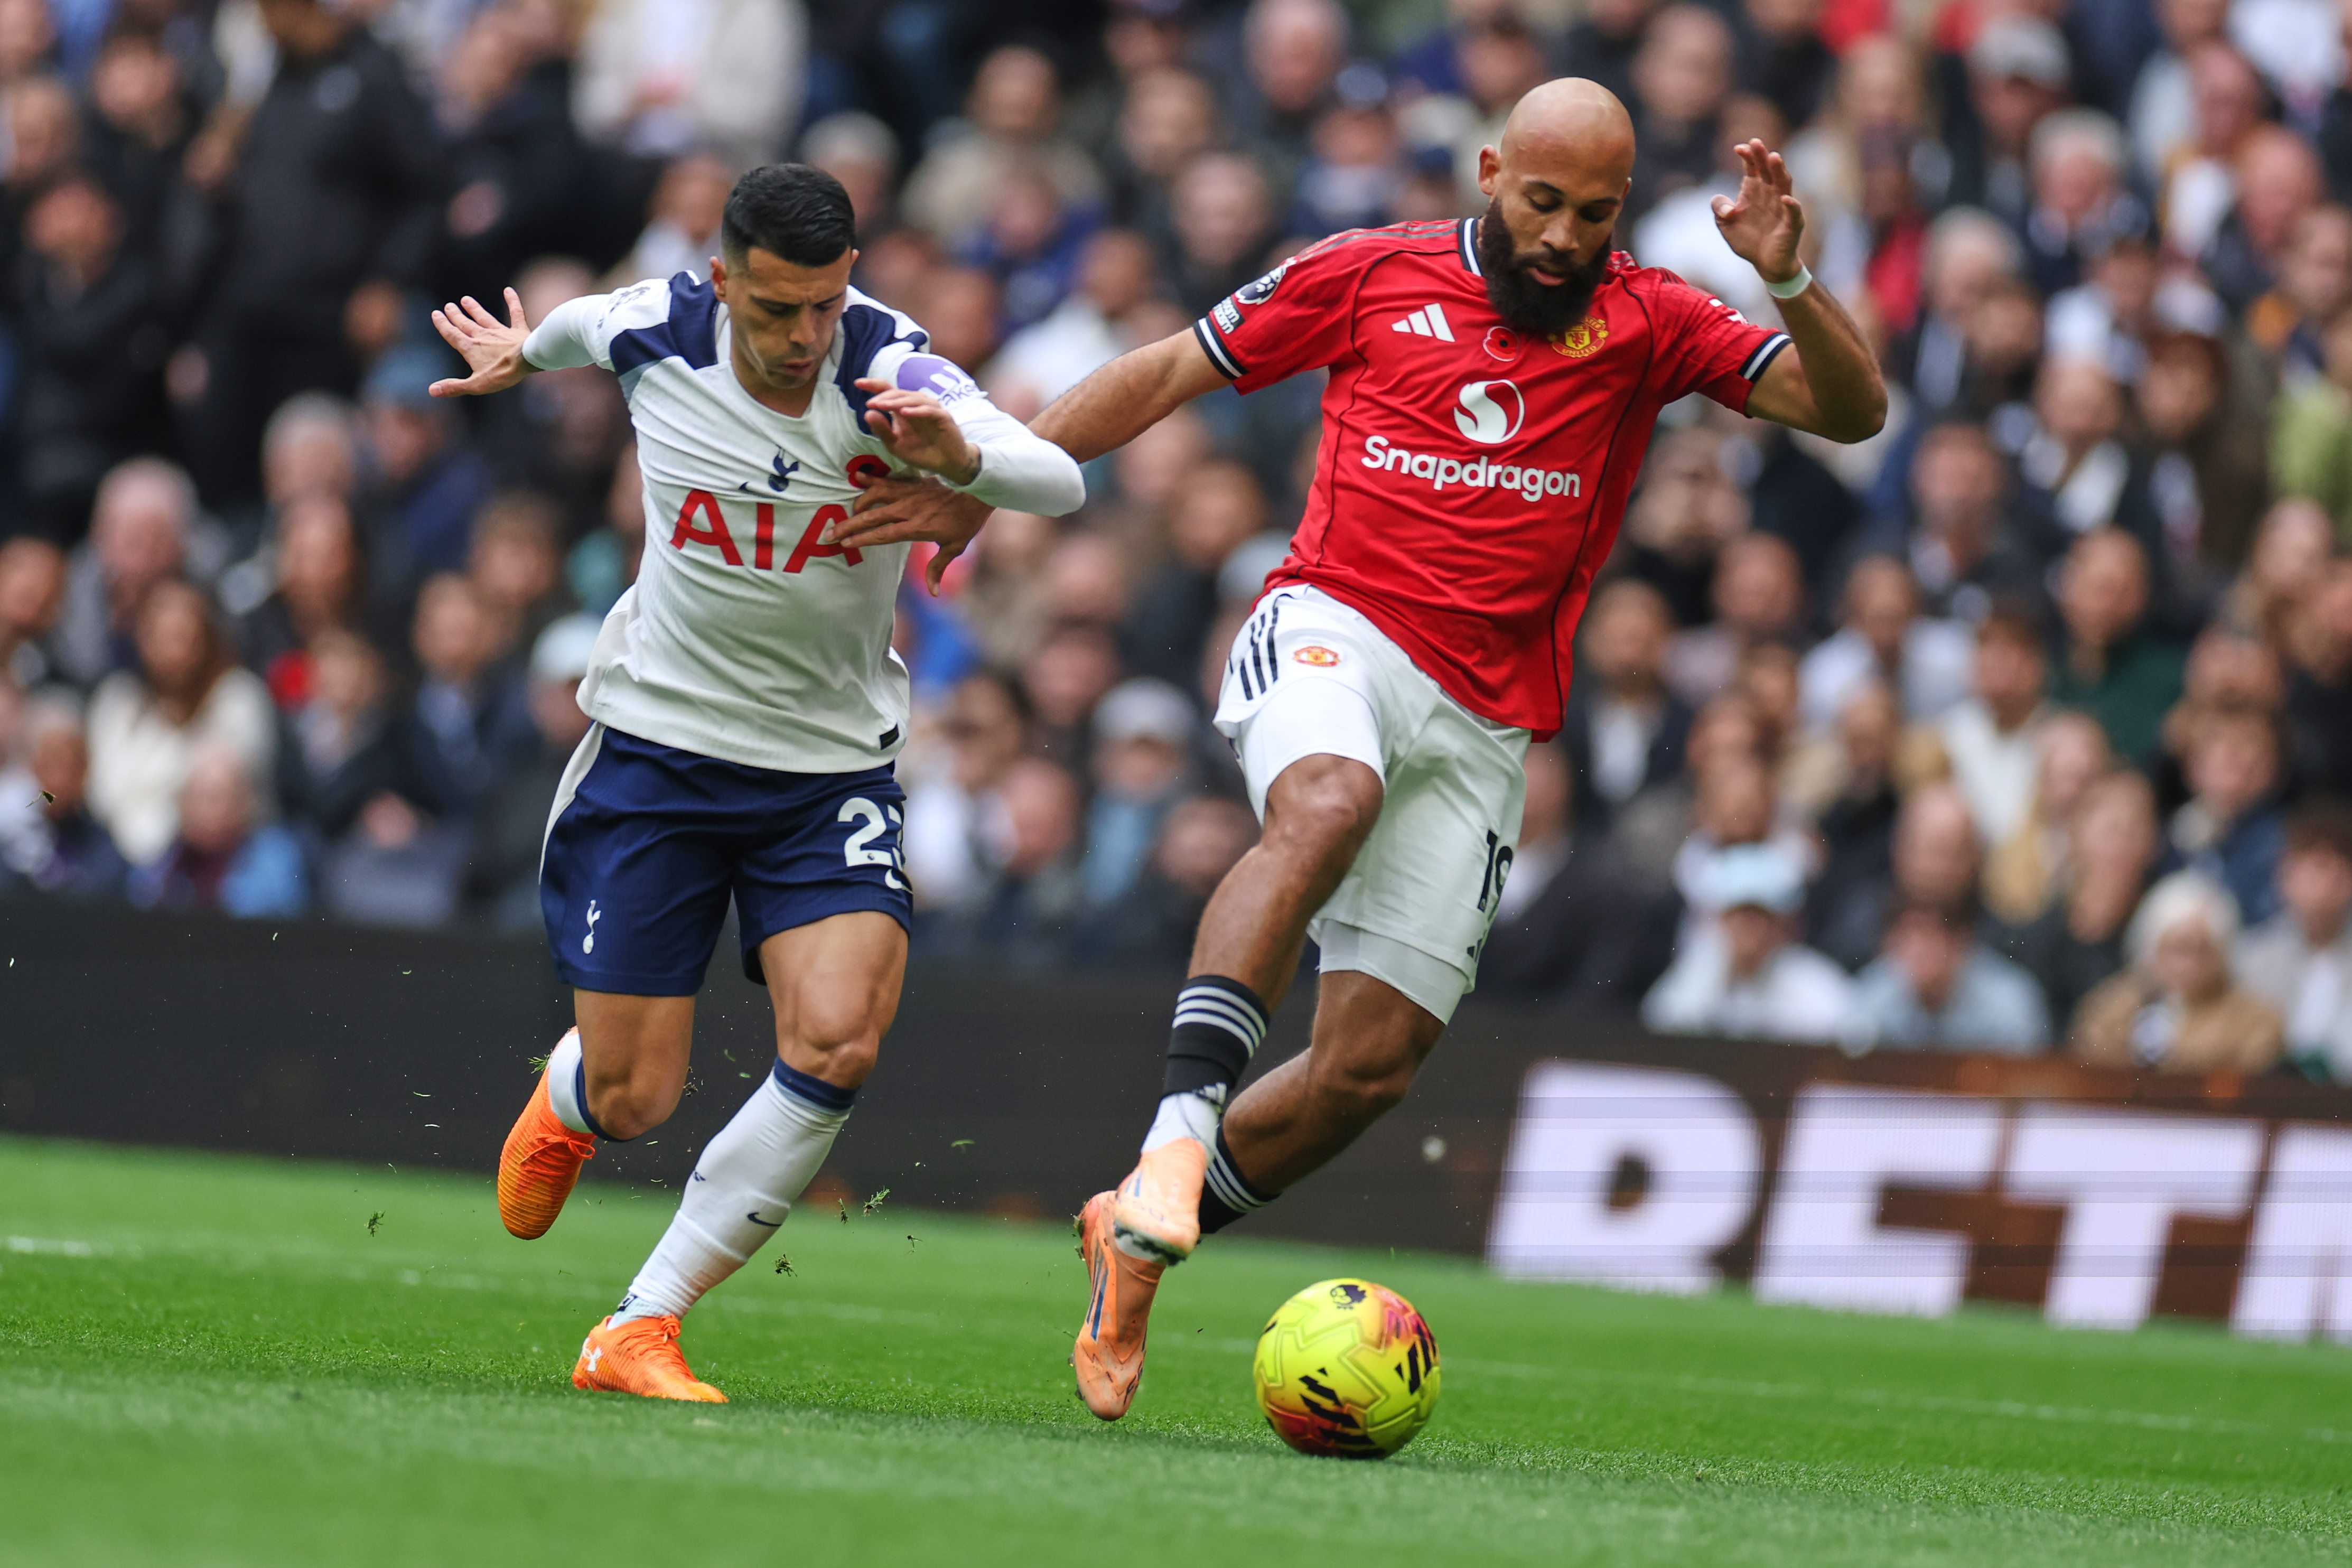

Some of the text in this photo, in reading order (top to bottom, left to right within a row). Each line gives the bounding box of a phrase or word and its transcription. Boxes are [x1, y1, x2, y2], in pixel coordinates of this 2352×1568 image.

[1562, 346, 1597, 356] UNITED
[1361, 435, 1580, 502] Snapdragon
[669, 489, 864, 574] AIA
